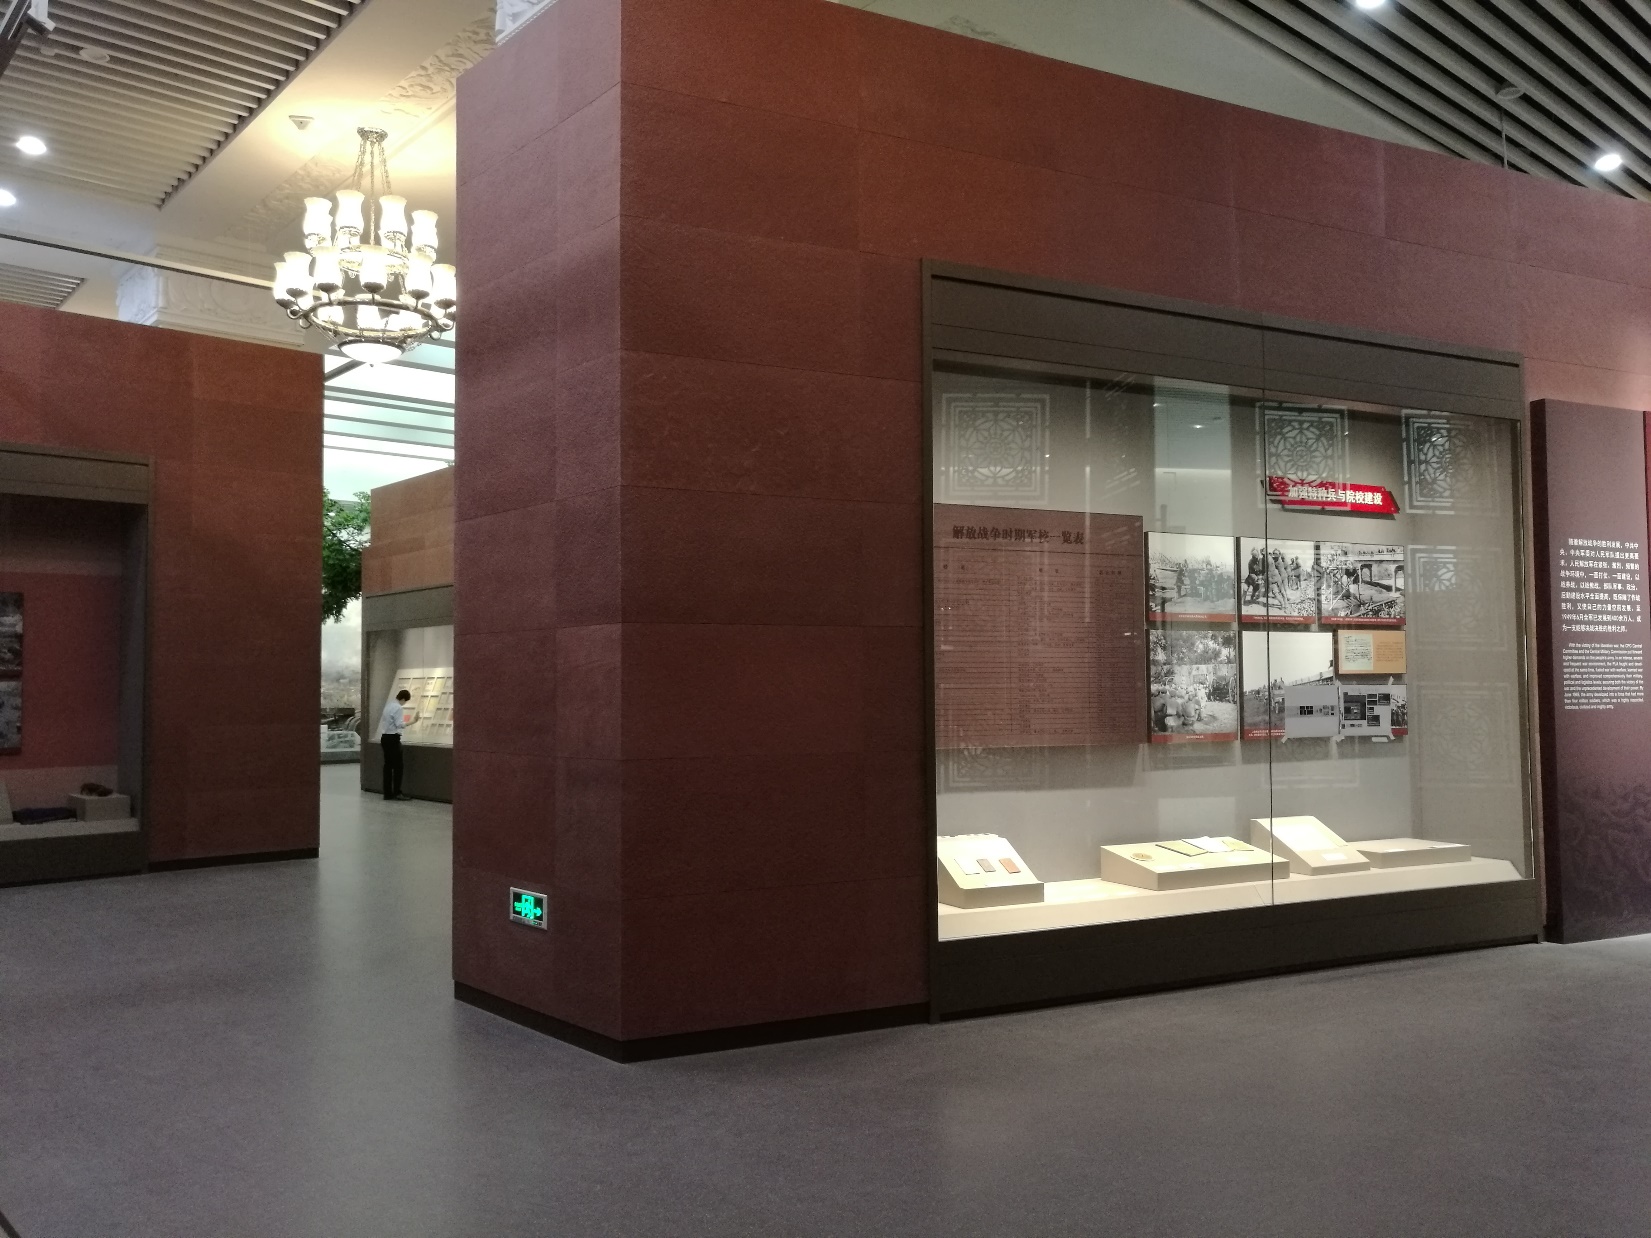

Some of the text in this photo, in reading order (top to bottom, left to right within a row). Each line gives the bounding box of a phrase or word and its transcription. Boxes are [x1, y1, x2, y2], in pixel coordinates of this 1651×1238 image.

[1288, 485, 1382, 505] 加强特种兵与院校建设
[952, 525, 1084, 544] 解放战争时期军校一览表
